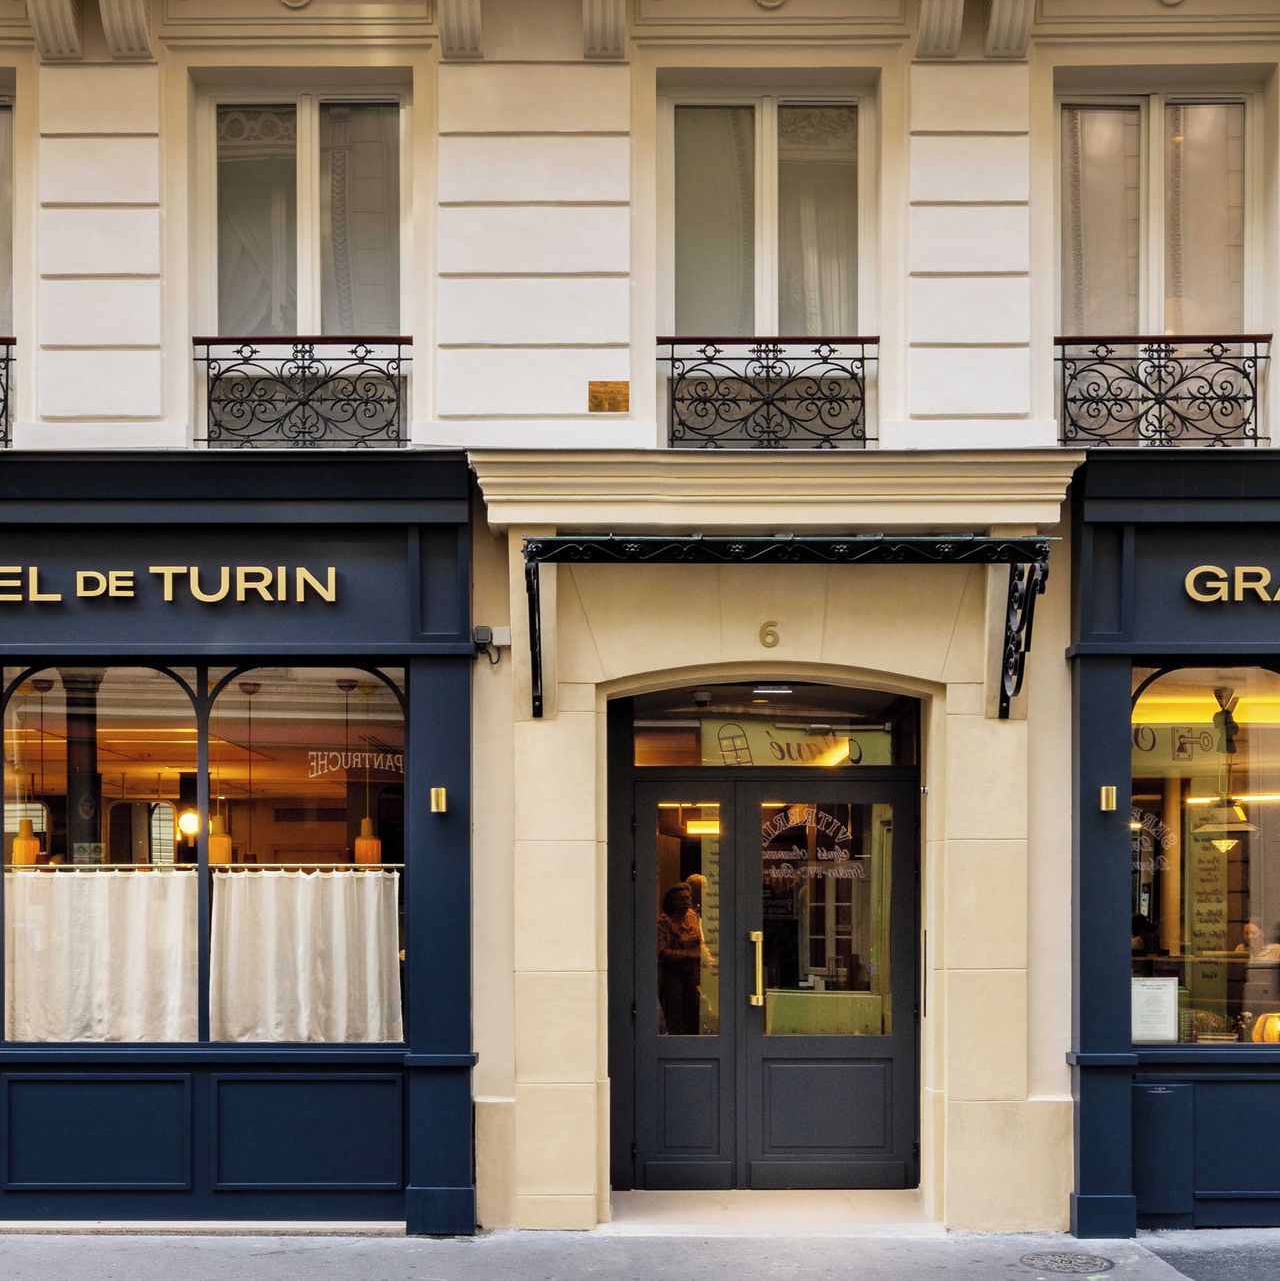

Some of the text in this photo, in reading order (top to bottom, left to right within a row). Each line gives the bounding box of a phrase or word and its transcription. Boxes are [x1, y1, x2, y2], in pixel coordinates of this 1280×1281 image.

[76, 570, 135, 597] DE
[148, 565, 336, 603] TURIN
[759, 620, 780, 649] 6
